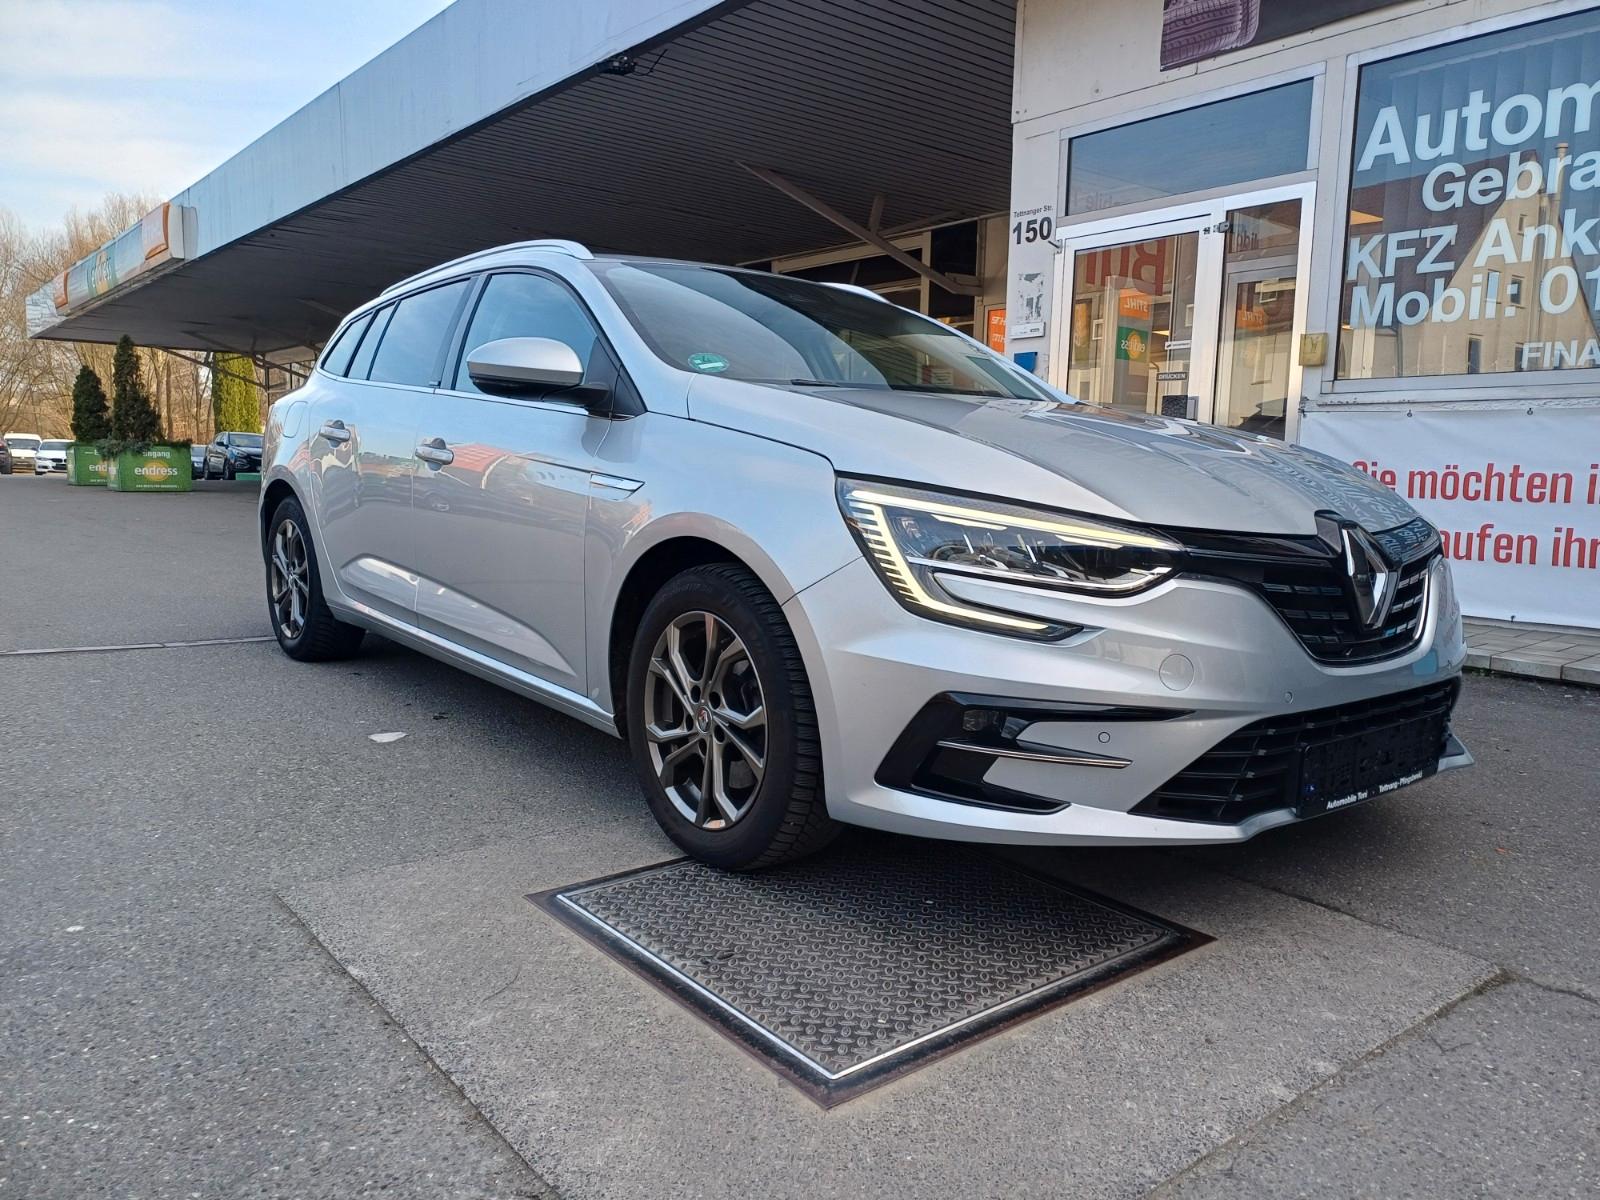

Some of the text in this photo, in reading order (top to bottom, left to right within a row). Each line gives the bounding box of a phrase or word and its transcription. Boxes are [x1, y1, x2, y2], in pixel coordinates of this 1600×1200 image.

[1422, 150, 1600, 212] Gebra
[1012, 216, 1053, 245] 150
[1347, 208, 1600, 281] KFZ Ank
[1350, 271, 1518, 329] Mobil:
[1522, 338, 1600, 370] FINA
[134, 466, 178, 476] endress
[1407, 463, 1574, 504] möchten
[1586, 464, 1600, 505] i
[1441, 523, 1538, 565] aufen
